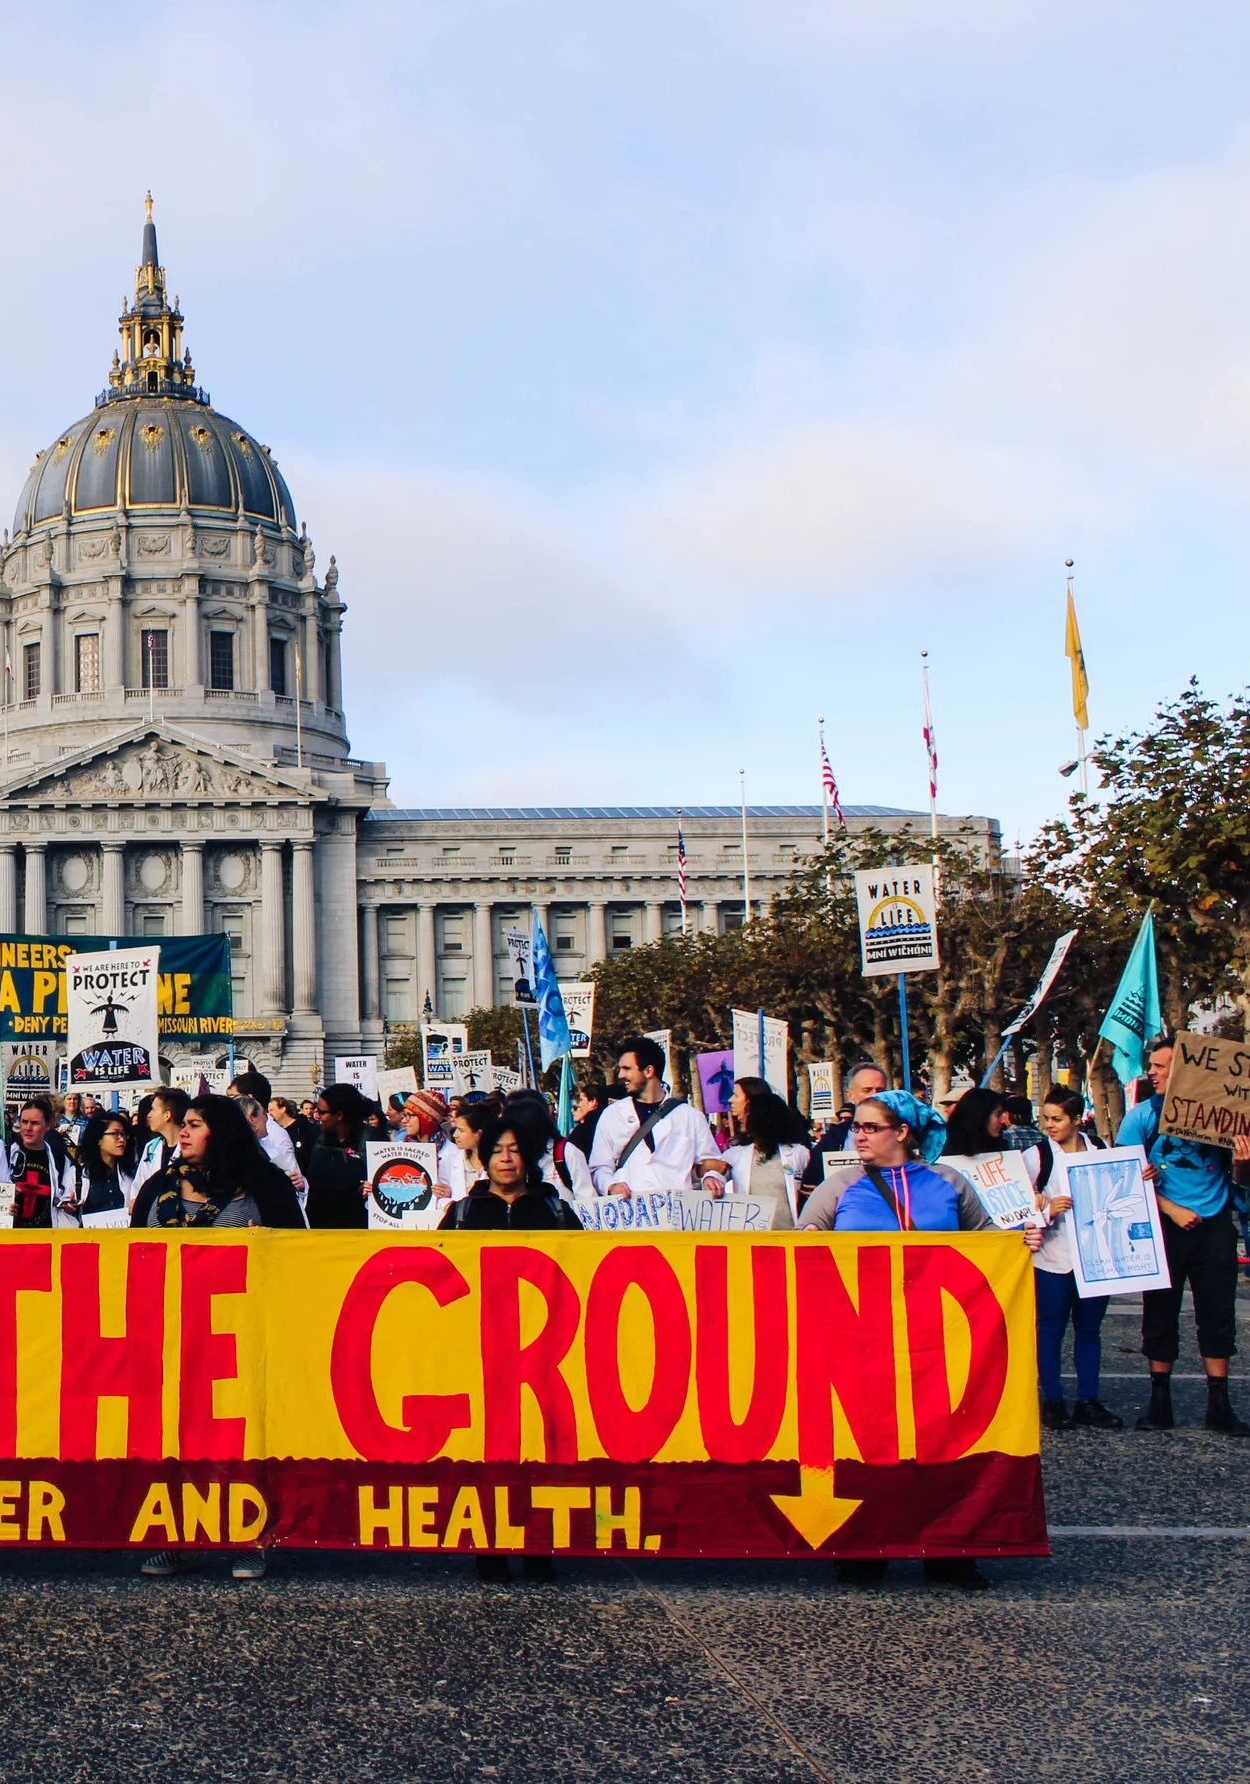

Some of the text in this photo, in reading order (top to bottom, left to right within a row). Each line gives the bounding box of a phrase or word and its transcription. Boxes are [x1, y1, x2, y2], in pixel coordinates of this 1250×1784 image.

[868, 880, 921, 899] WATER
[881, 909, 913, 926] LIFE
[82, 964, 96, 972] WE
[110, 962, 129, 970] HERE
[74, 970, 150, 990] PROTECT
[564, 996, 591, 1005] ROTECT
[14, 1016, 50, 1033] DENY
[200, 1016, 233, 1034] RIVER
[570, 1033, 586, 1041] TER
[12, 1045, 48, 1056] WATER
[81, 1048, 146, 1066] WATER
[1181, 1043, 1220, 1072] WE
[18, 1065, 40, 1076] LIFE
[345, 1060, 367, 1068] WATER
[454, 1058, 488, 1067] PROTECT
[95, 1066, 130, 1076] IS LIFE
[353, 1072, 360, 1080] IS
[1224, 1084, 1250, 1100] WIT
[1164, 1096, 1250, 1136] STANDIN
[374, 1146, 396, 1156] WATER
[404, 1147, 430, 1158] SACRED
[976, 1158, 1012, 1188] LIFE
[373, 1213, 388, 1224] STOP
[1000, 1206, 1036, 1224] NO DAPL
[330, 1245, 1009, 1465] GROUND
[129, 1482, 268, 1543] AND
[358, 1485, 662, 1550] HEALTH.
